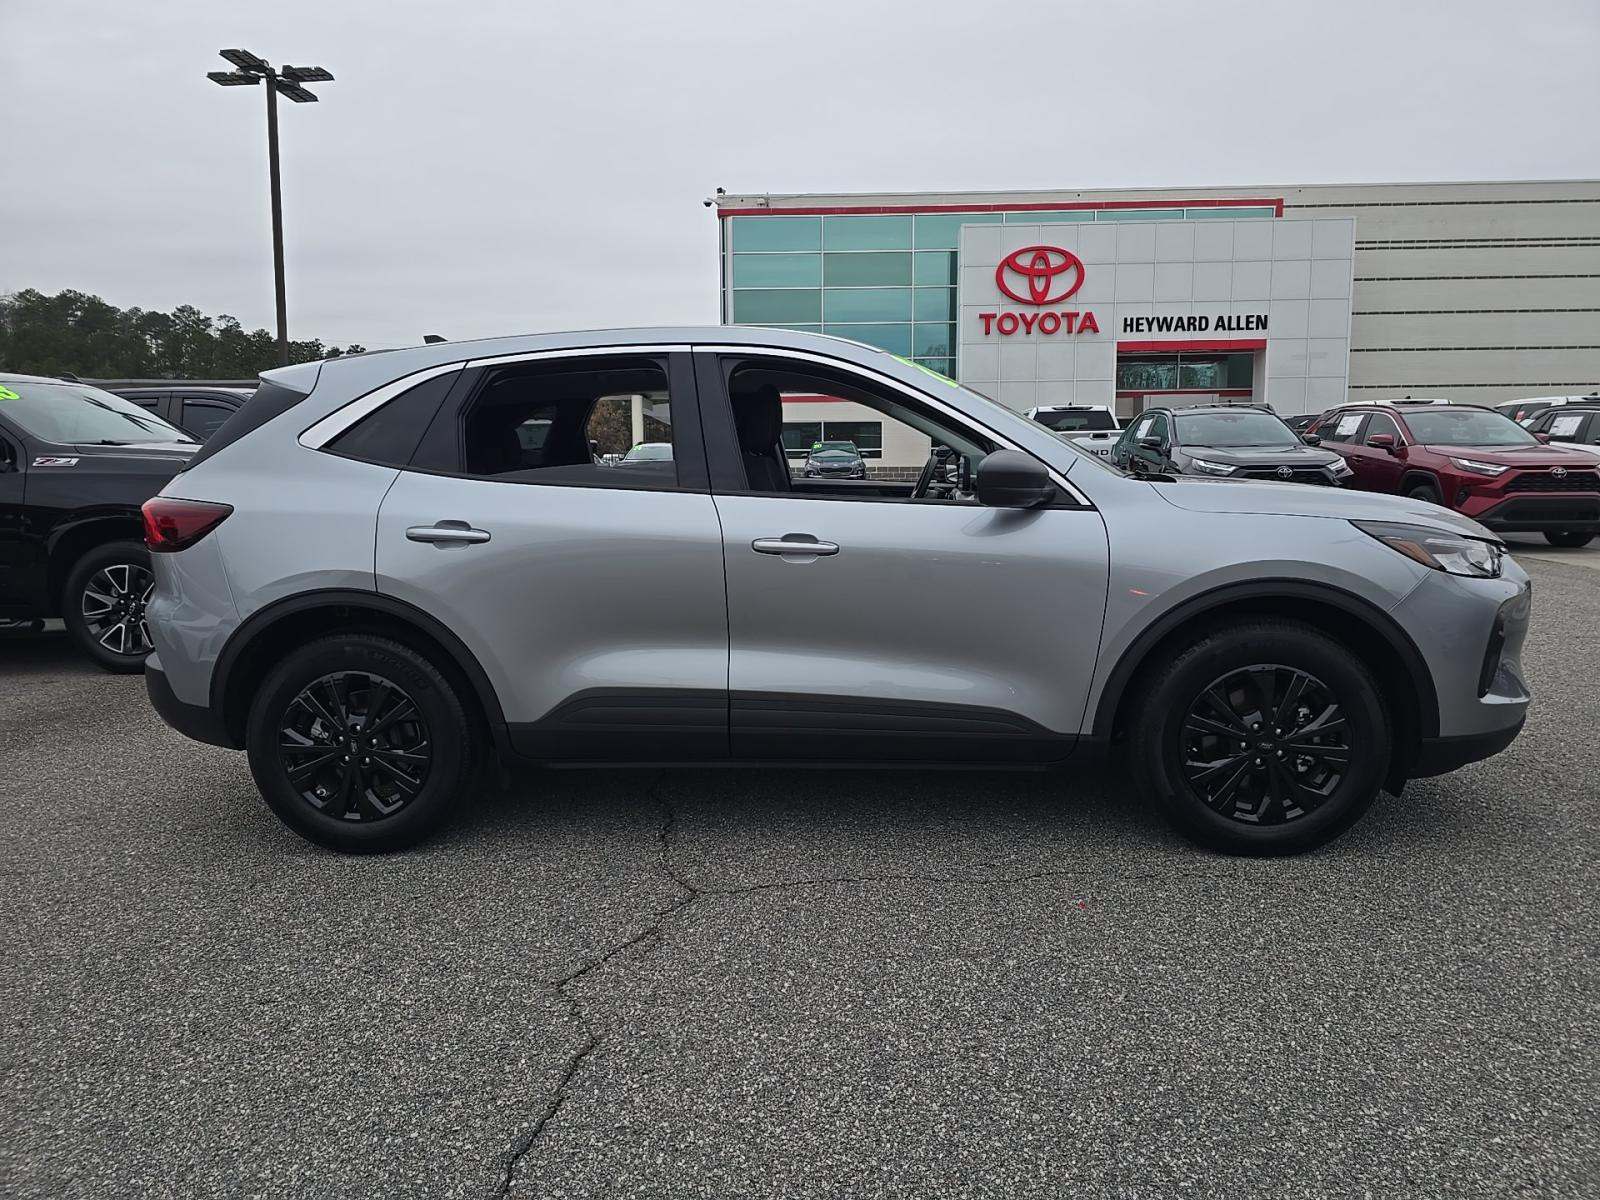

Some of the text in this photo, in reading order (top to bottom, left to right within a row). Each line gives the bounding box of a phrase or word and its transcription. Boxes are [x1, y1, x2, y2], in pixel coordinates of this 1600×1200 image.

[979, 311, 1099, 335] TOYOTA
[1123, 315, 1268, 332] HEYWARD ALLEN
